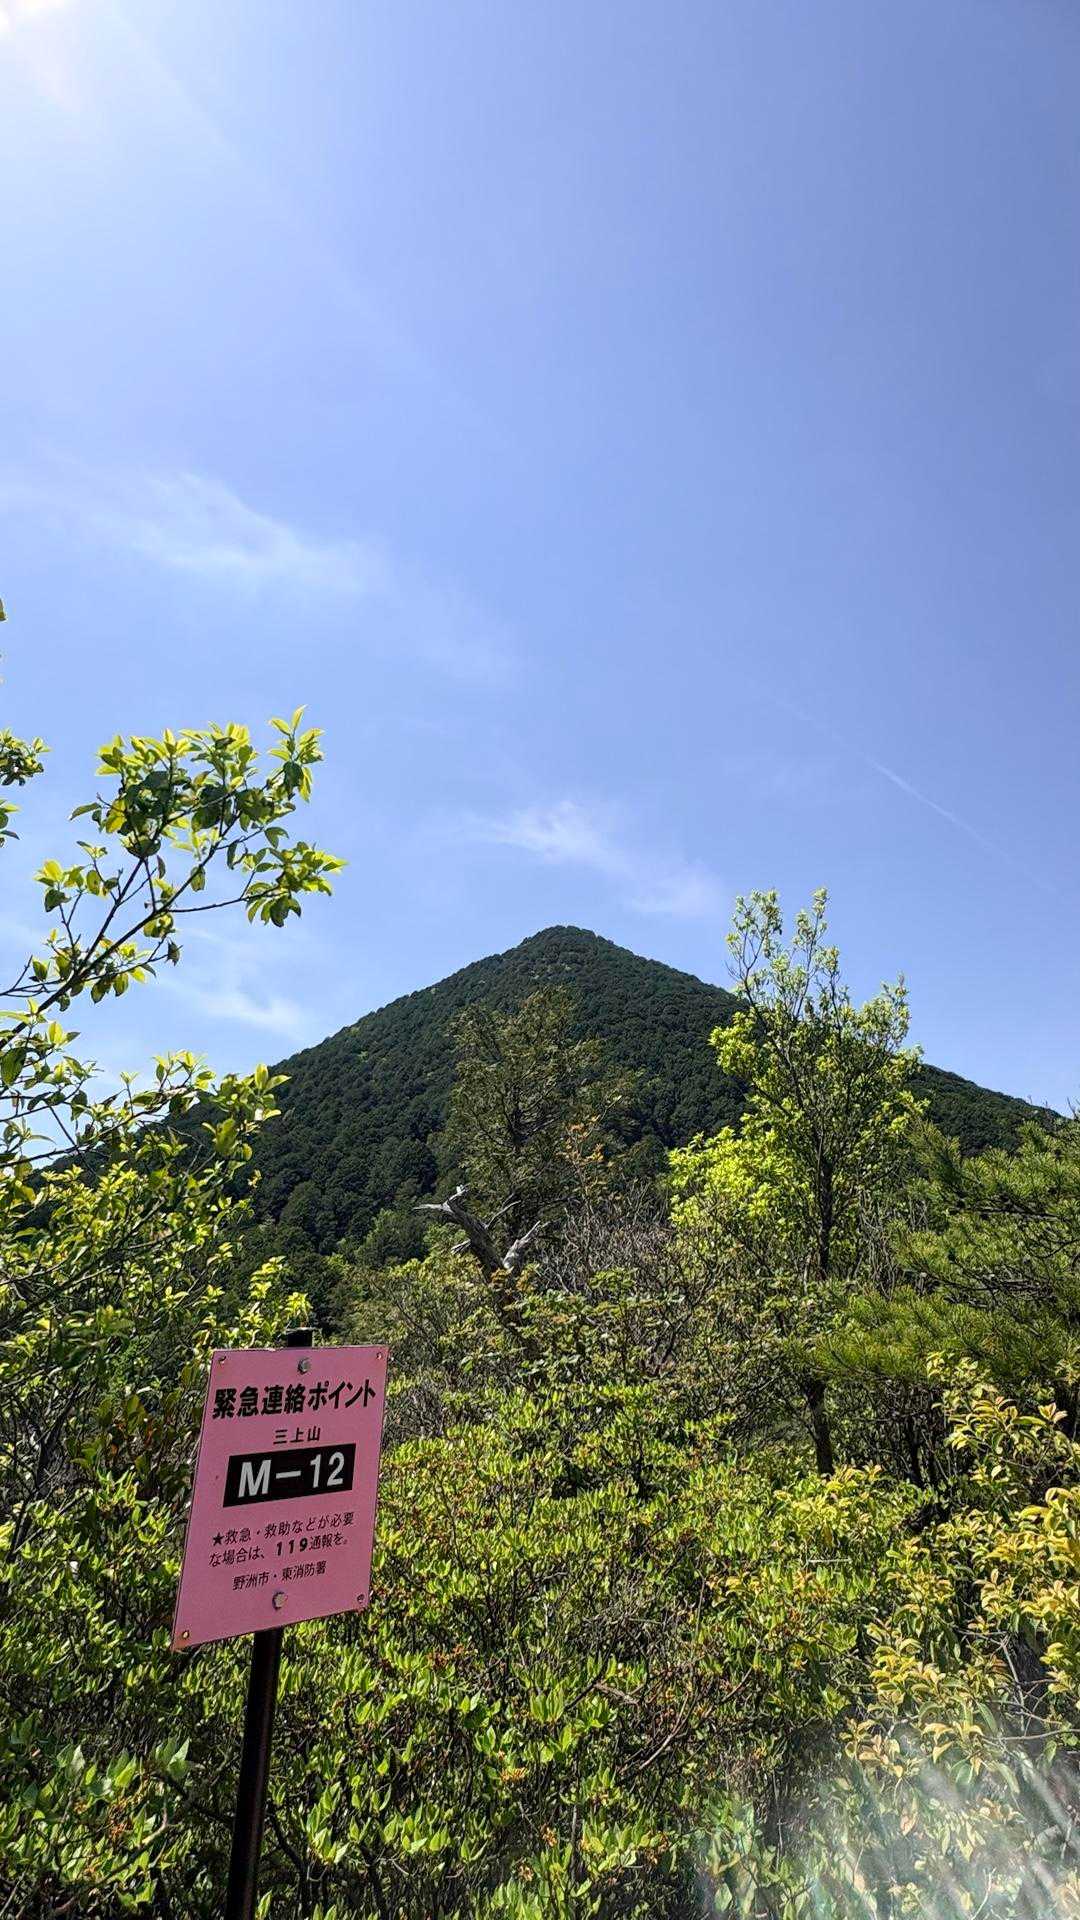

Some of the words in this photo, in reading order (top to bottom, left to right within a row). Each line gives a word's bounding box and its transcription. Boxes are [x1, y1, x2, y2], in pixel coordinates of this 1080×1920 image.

[212, 1379, 376, 1419] 緊急連絡ポイント
[273, 1426, 321, 1445] 三上山
[232, 1560, 327, 1591] 野洲市・東消防署
